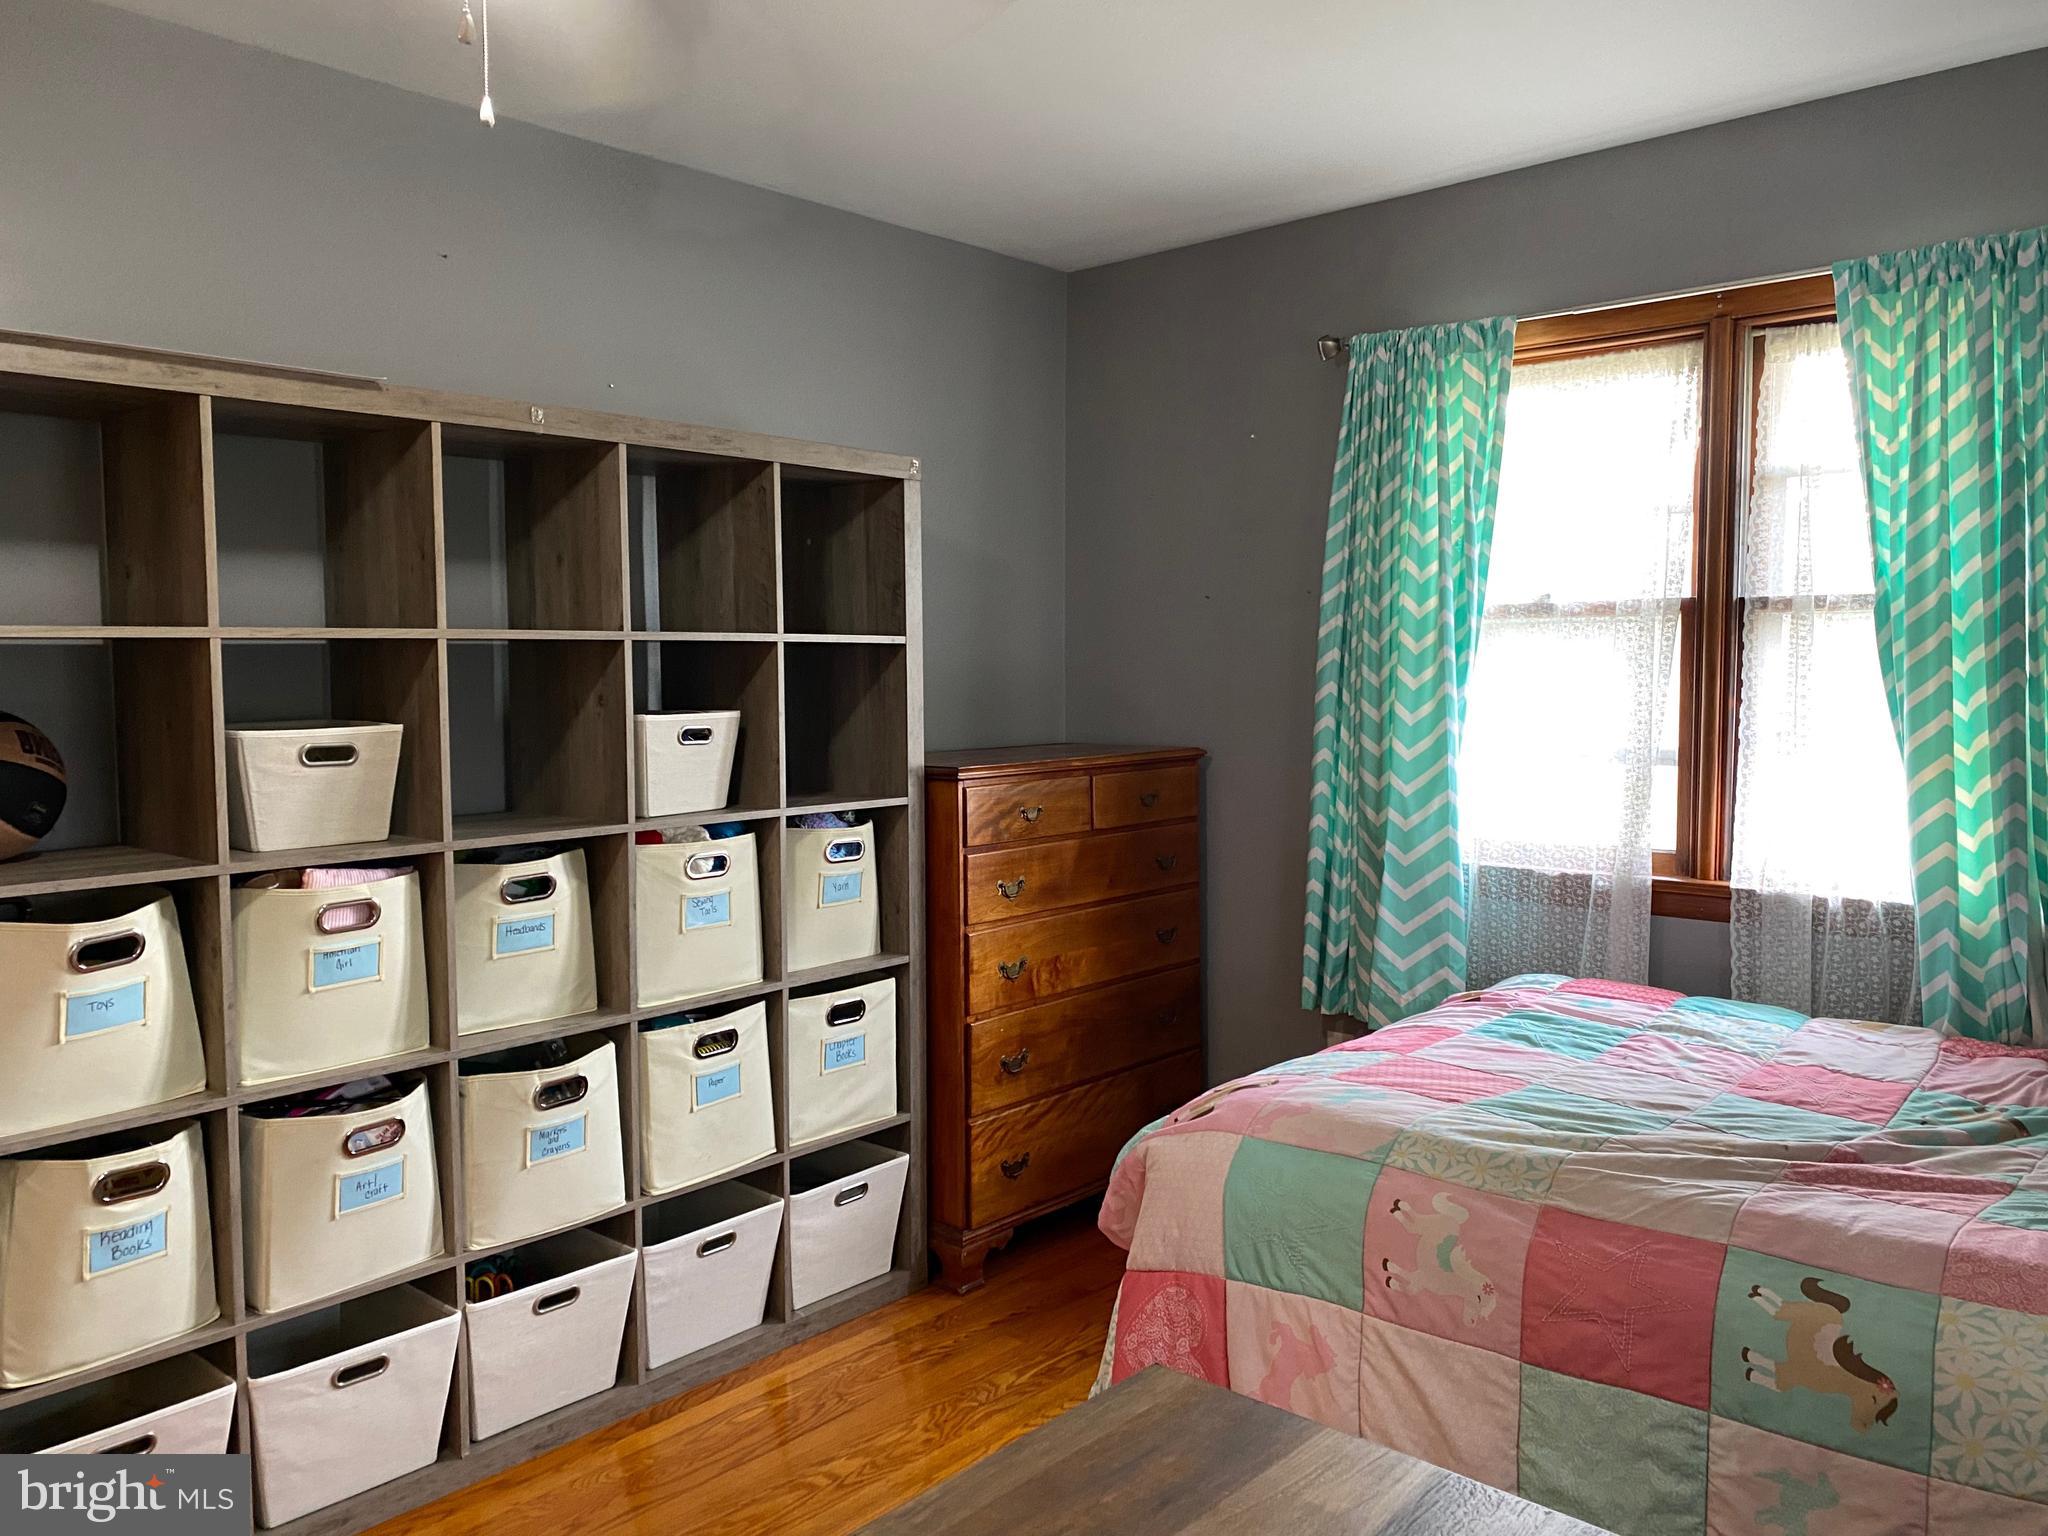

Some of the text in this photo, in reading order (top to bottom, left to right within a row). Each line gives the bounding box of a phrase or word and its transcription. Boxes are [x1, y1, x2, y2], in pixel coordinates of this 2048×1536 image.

[505, 922, 546, 937] Headbands
[100, 1219, 153, 1247] Reading
[111, 1239, 152, 1261] Books
